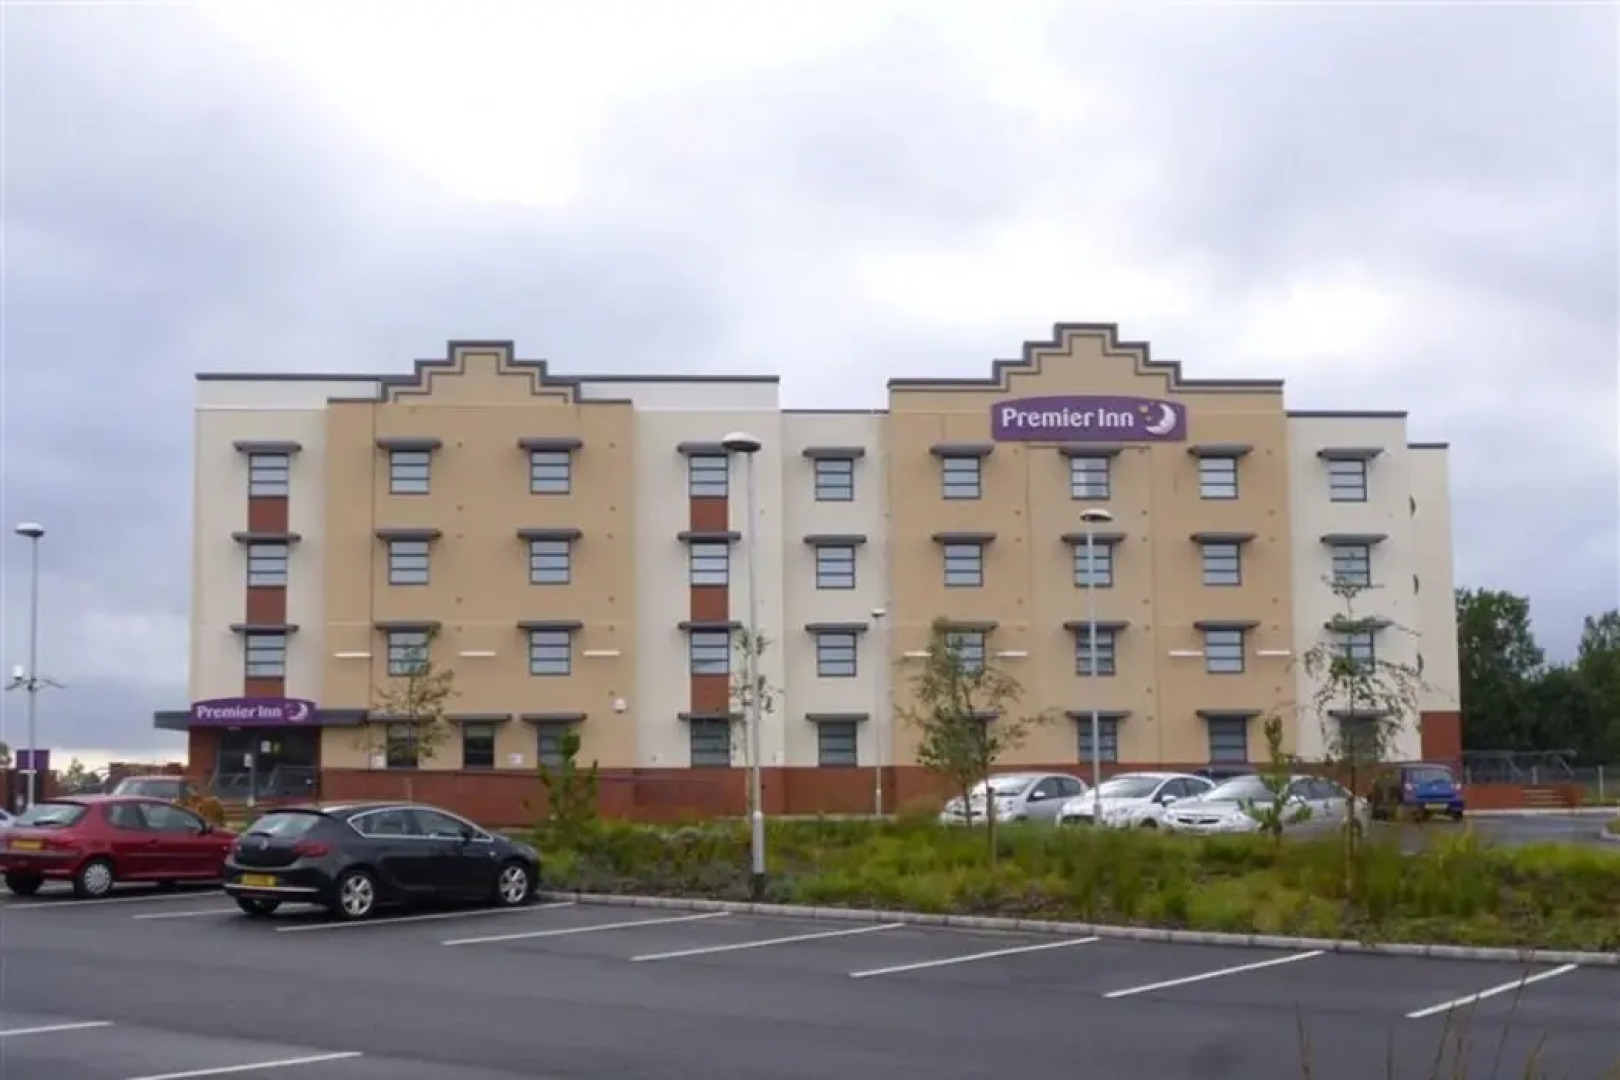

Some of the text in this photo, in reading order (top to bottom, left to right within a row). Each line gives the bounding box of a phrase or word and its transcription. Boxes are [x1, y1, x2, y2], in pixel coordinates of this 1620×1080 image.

[1002, 407, 1134, 427] Premier Inn
[197, 705, 282, 719] Premier Inn
